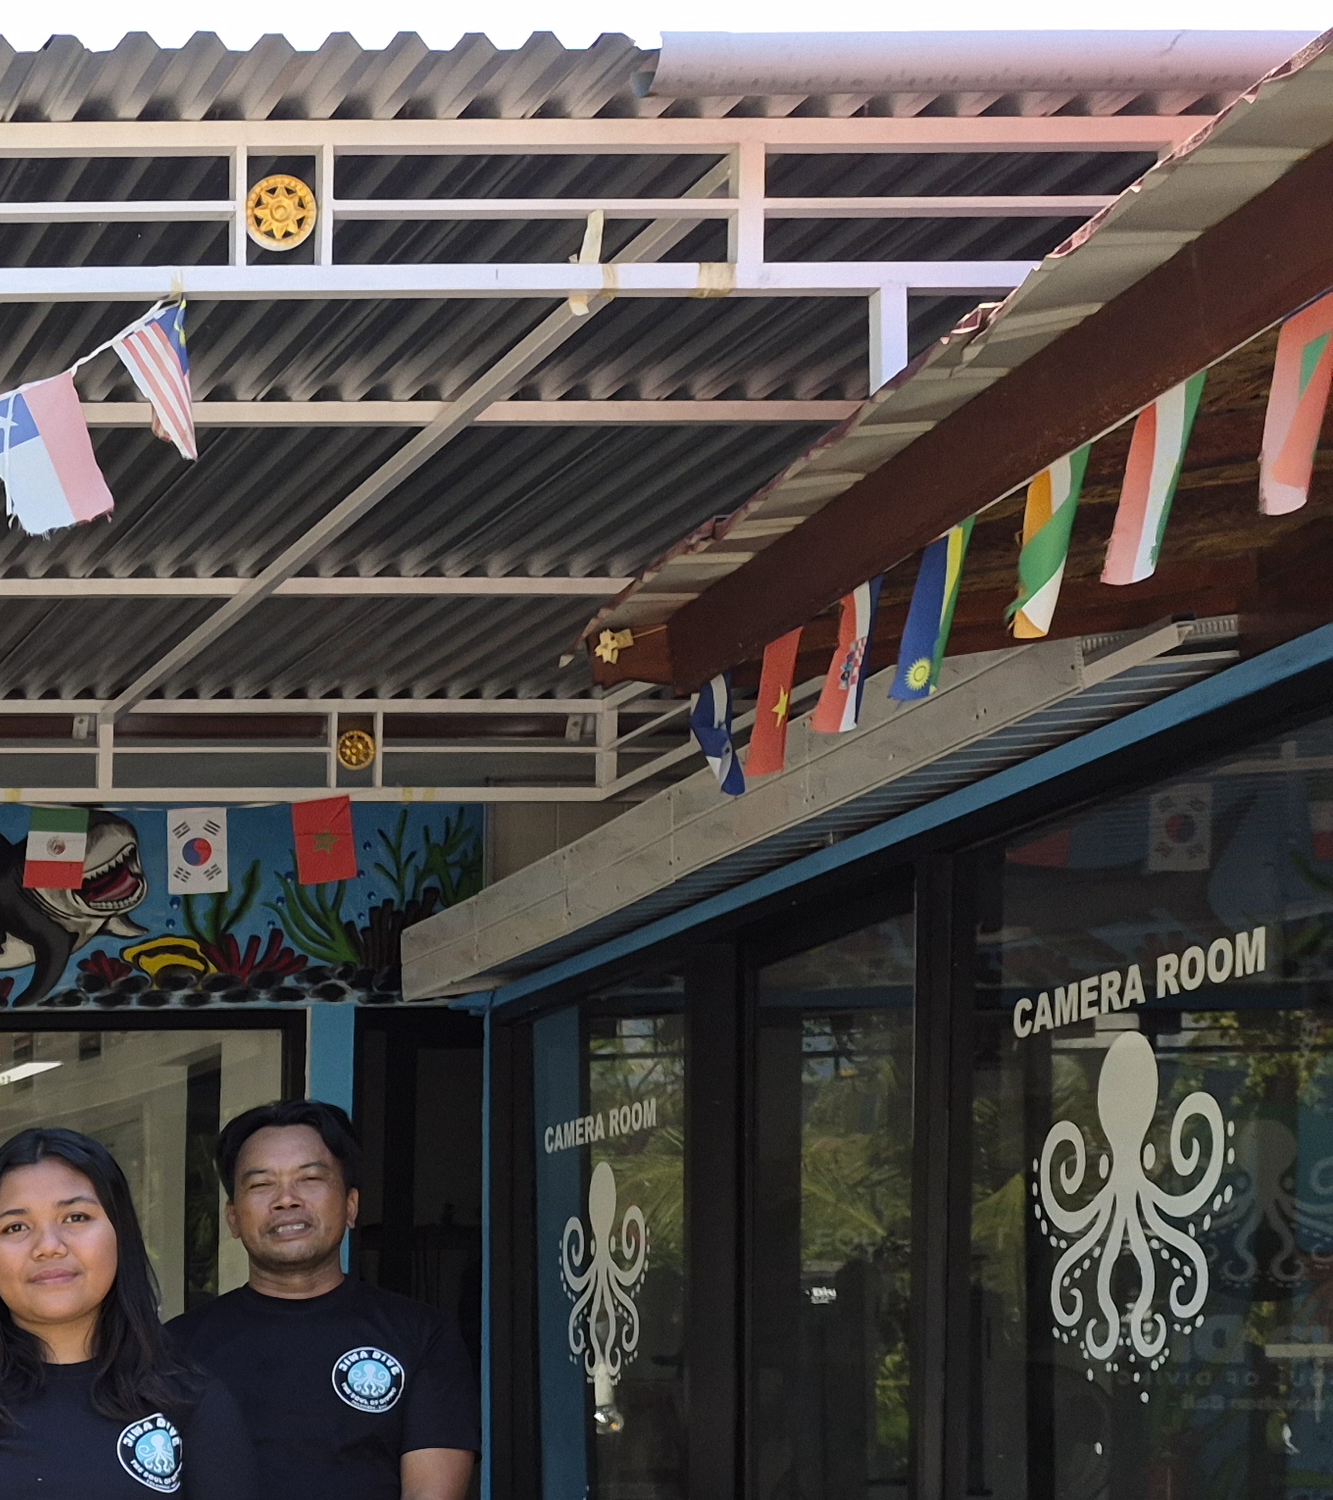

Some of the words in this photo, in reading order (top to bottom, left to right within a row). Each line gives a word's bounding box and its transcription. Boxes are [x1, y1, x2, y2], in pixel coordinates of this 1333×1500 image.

[1013, 963, 1146, 1038] CAMERA
[1156, 926, 1266, 999] ROOM
[544, 1112, 606, 1154] CAMERA
[609, 1098, 657, 1137] ROOM
[372, 1350, 401, 1376] DIVE
